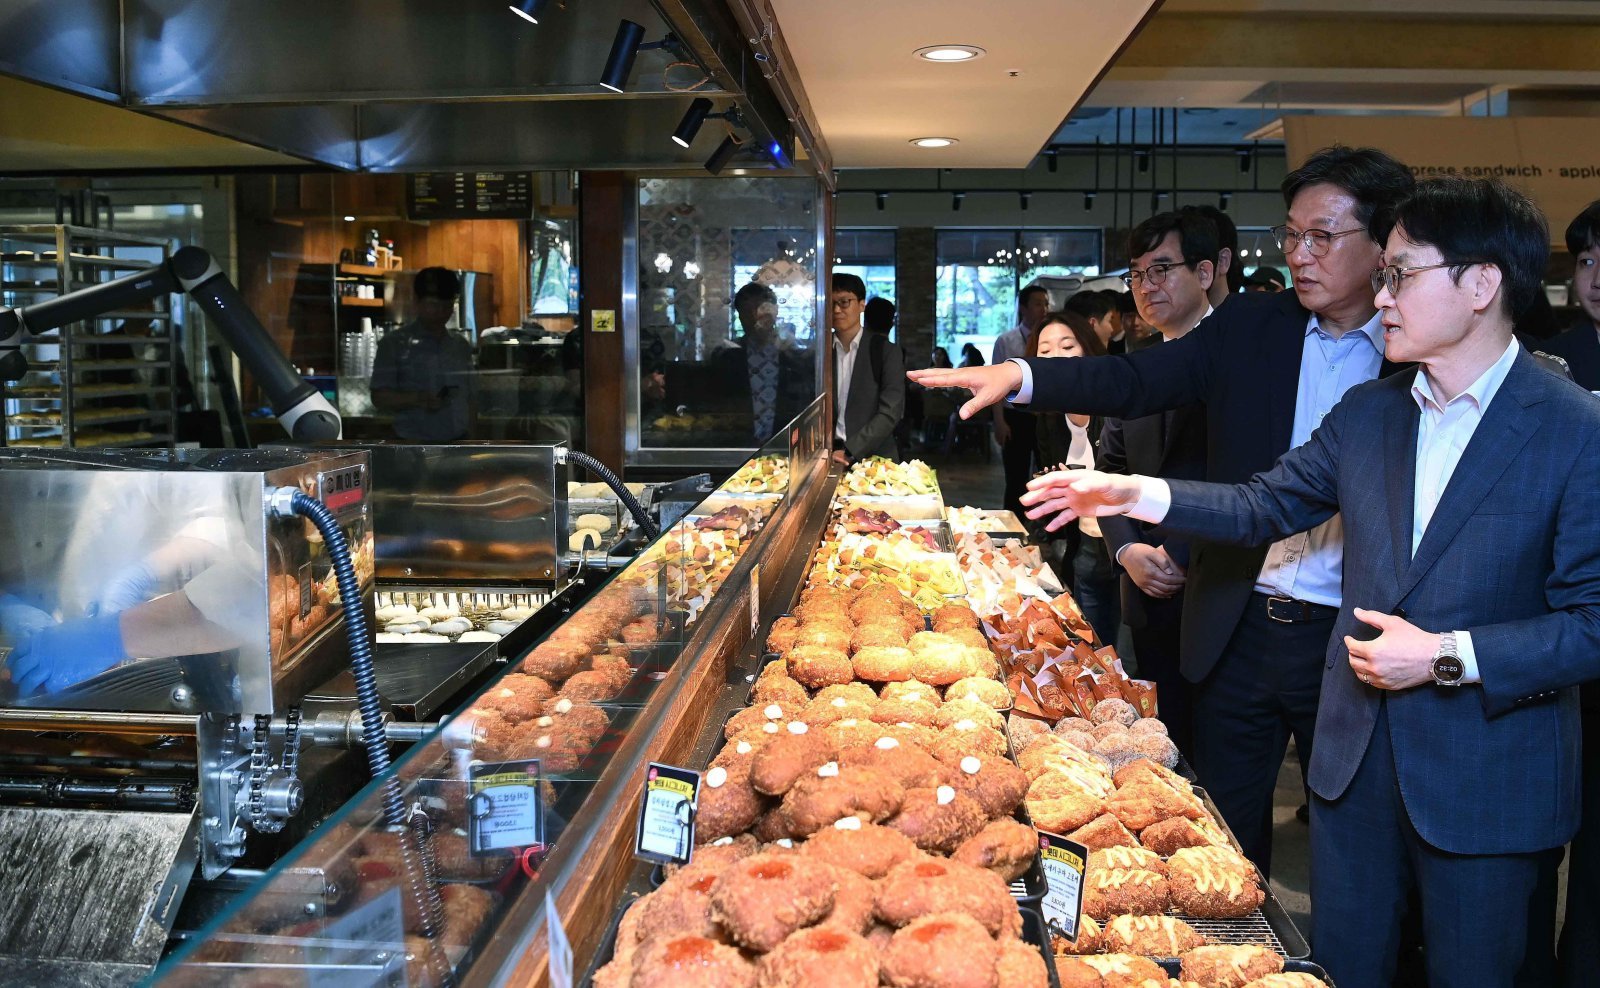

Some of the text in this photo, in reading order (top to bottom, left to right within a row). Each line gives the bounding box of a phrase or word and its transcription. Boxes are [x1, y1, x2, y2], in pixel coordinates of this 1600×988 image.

[1463, 164, 1542, 177] sandwich
[1047, 848, 1079, 866] 롯데 시그니처
